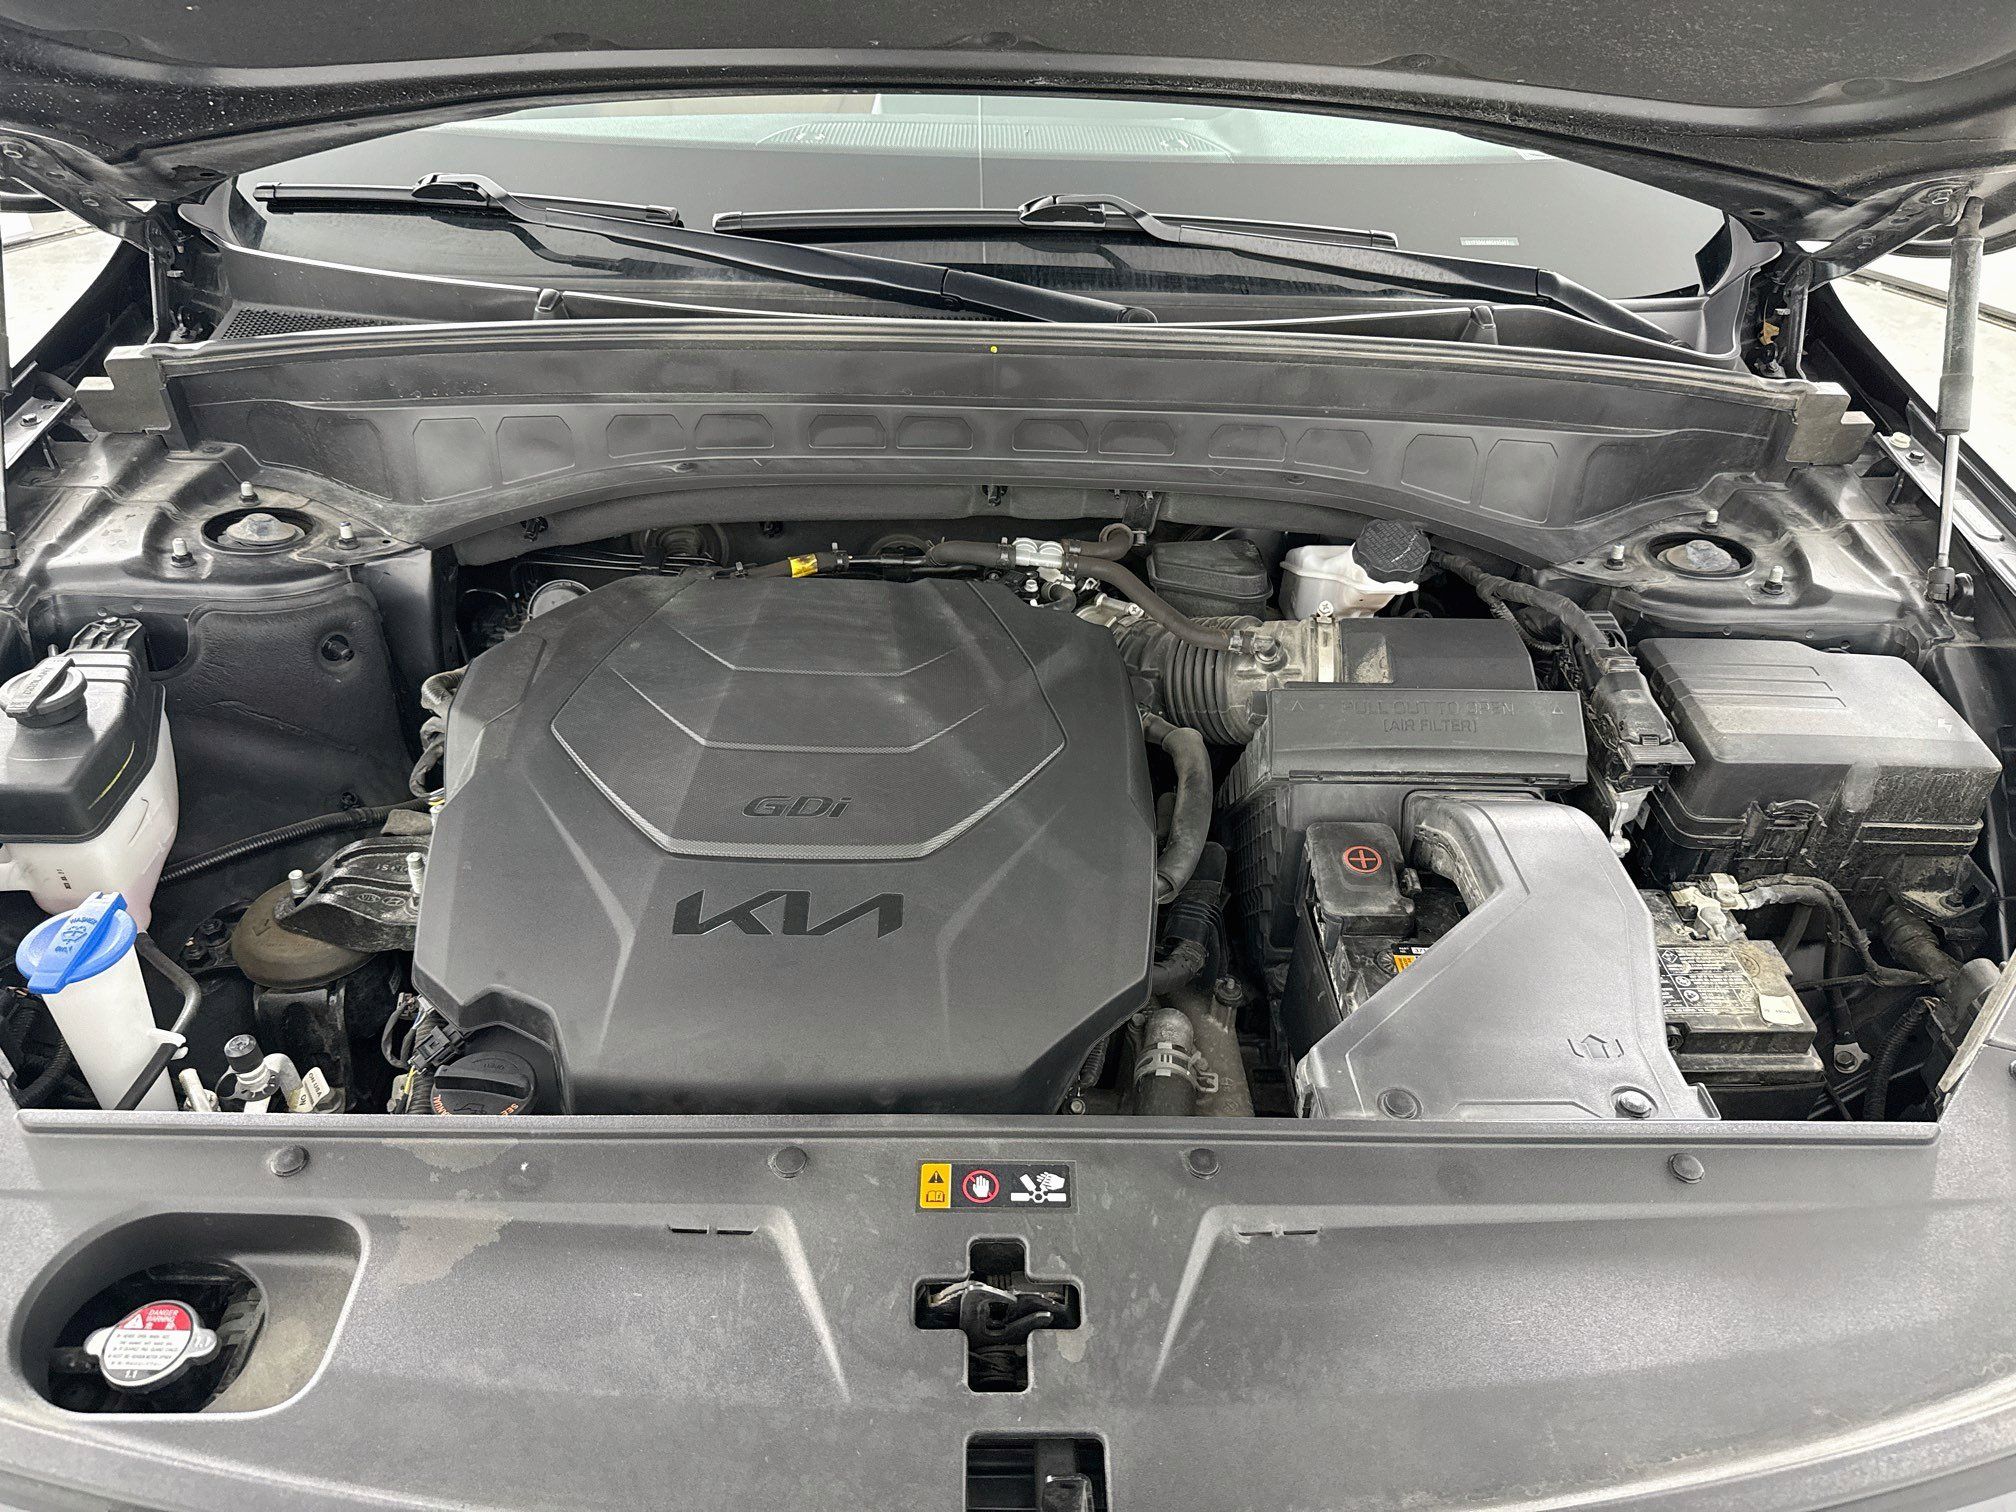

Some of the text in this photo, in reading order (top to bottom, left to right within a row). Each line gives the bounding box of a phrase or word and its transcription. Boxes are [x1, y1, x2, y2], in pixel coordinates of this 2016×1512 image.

[1341, 701, 1515, 716] PULL OUT TO OPEN
[742, 796, 852, 819] GDi
[672, 889, 904, 939] KIA
